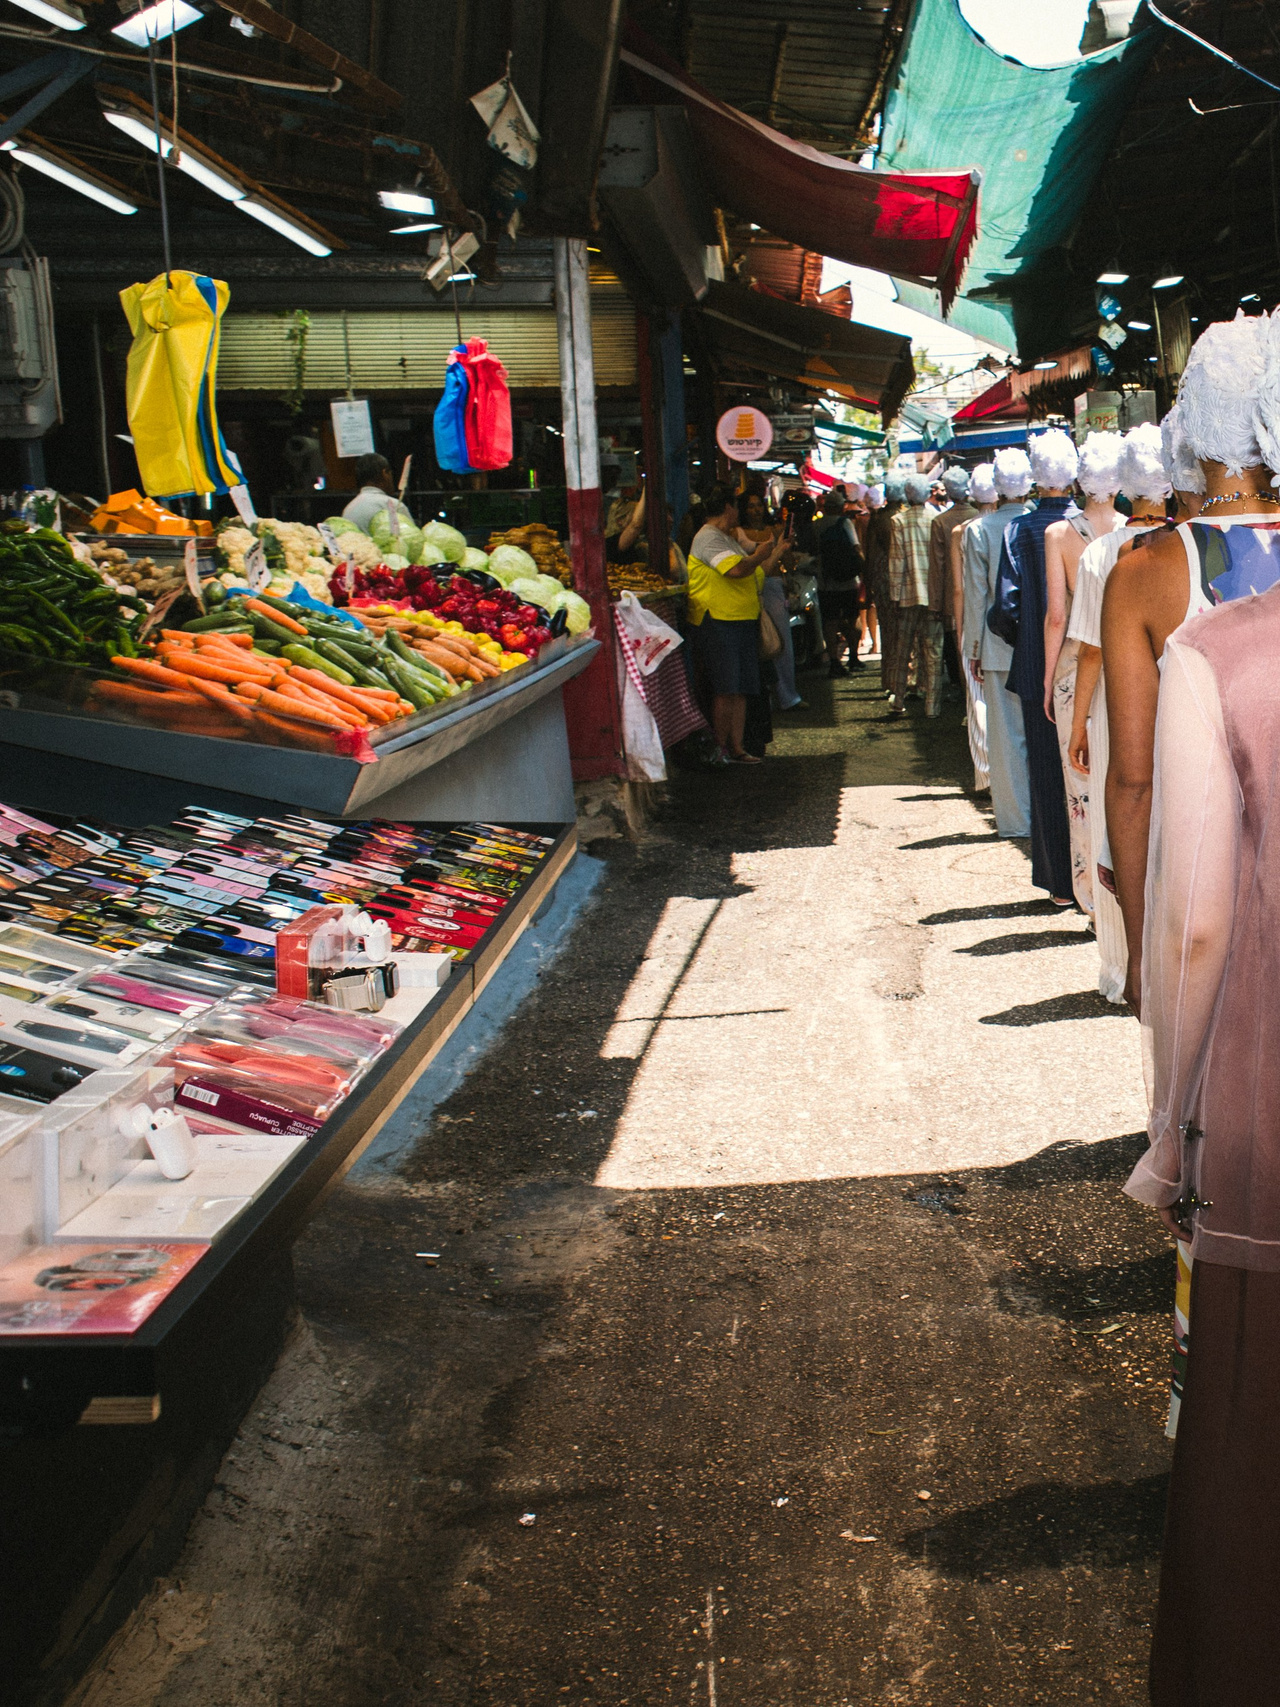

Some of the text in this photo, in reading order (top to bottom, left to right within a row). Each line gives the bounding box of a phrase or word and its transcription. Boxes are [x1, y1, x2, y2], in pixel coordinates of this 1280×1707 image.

[727, 438, 763, 447] קיורטוש
[249, 1112, 280, 1127] CUPUAÇU
[292, 1120, 319, 1134] PEPTIDE
